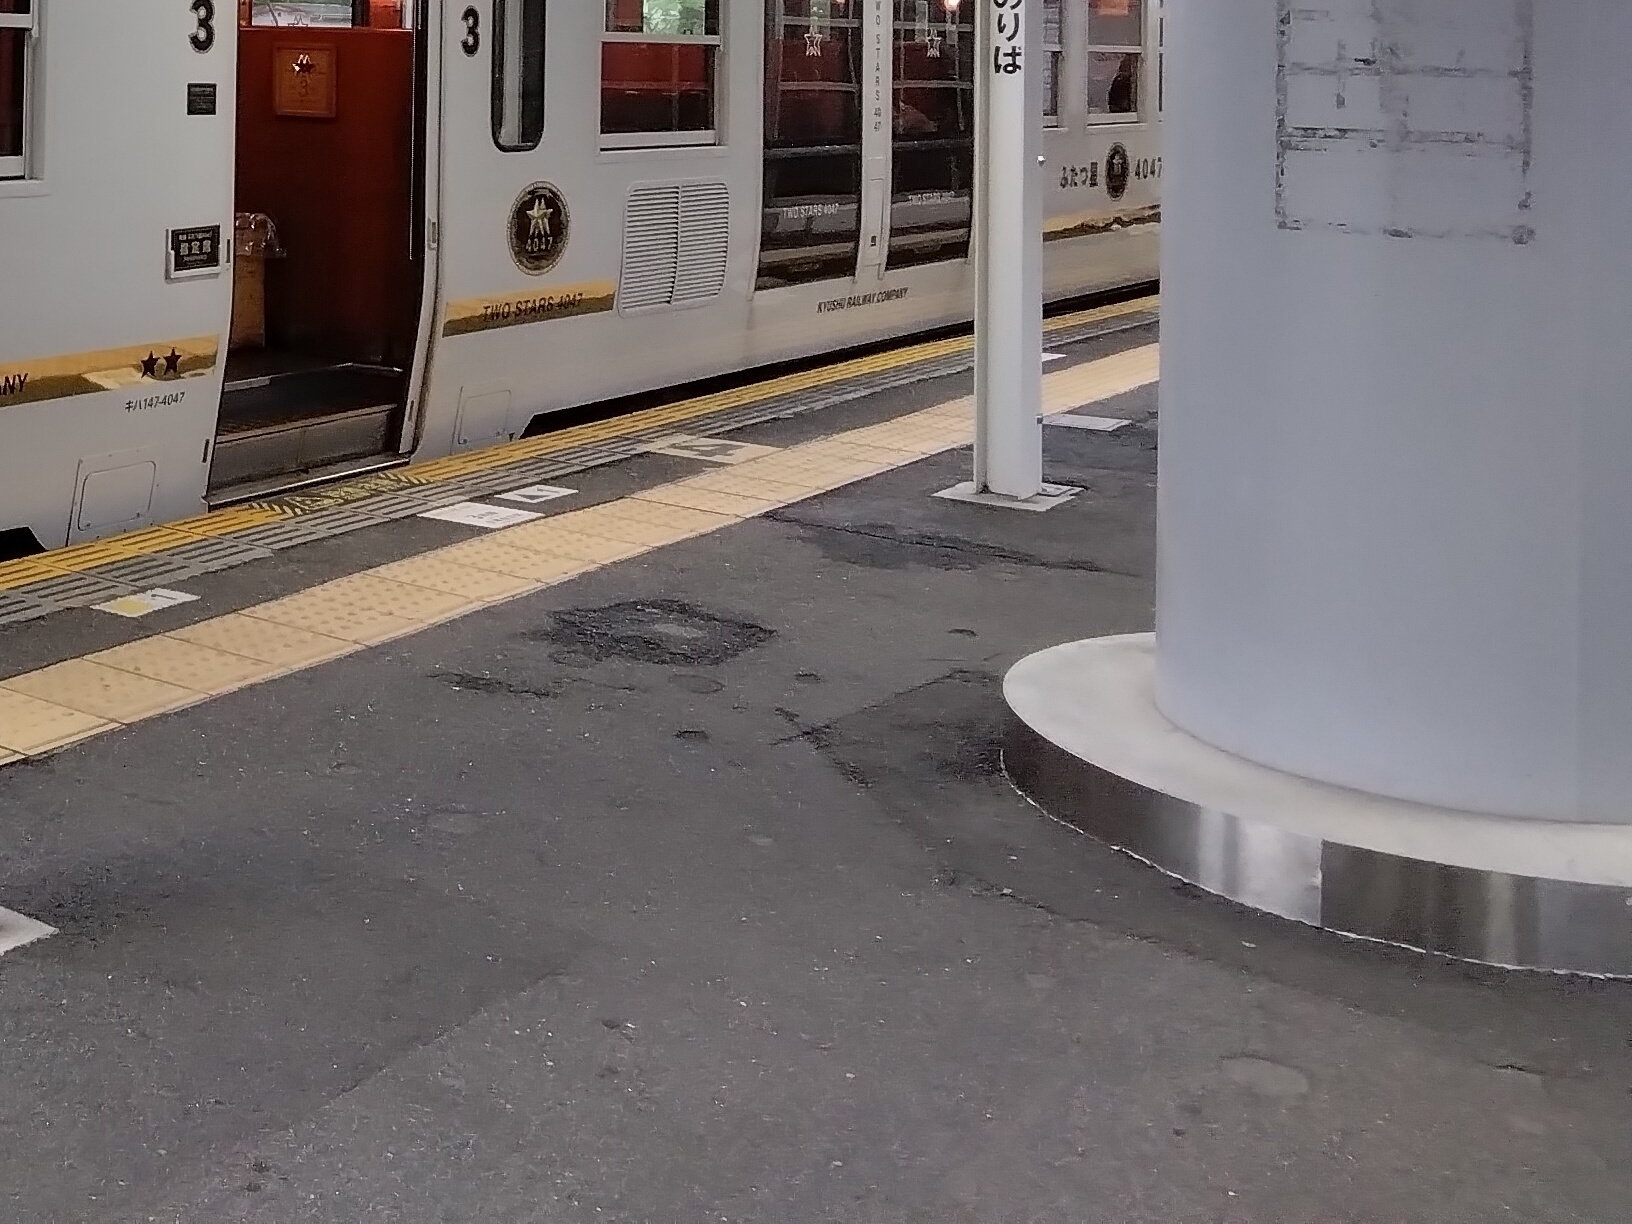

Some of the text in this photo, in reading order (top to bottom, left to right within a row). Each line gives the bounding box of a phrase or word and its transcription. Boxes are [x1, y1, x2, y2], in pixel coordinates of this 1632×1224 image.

[460, 5, 481, 57] 3
[1134, 157, 1163, 180] 4047
[482, 301, 512, 323] TWO
[514, 295, 555, 318] STARS
